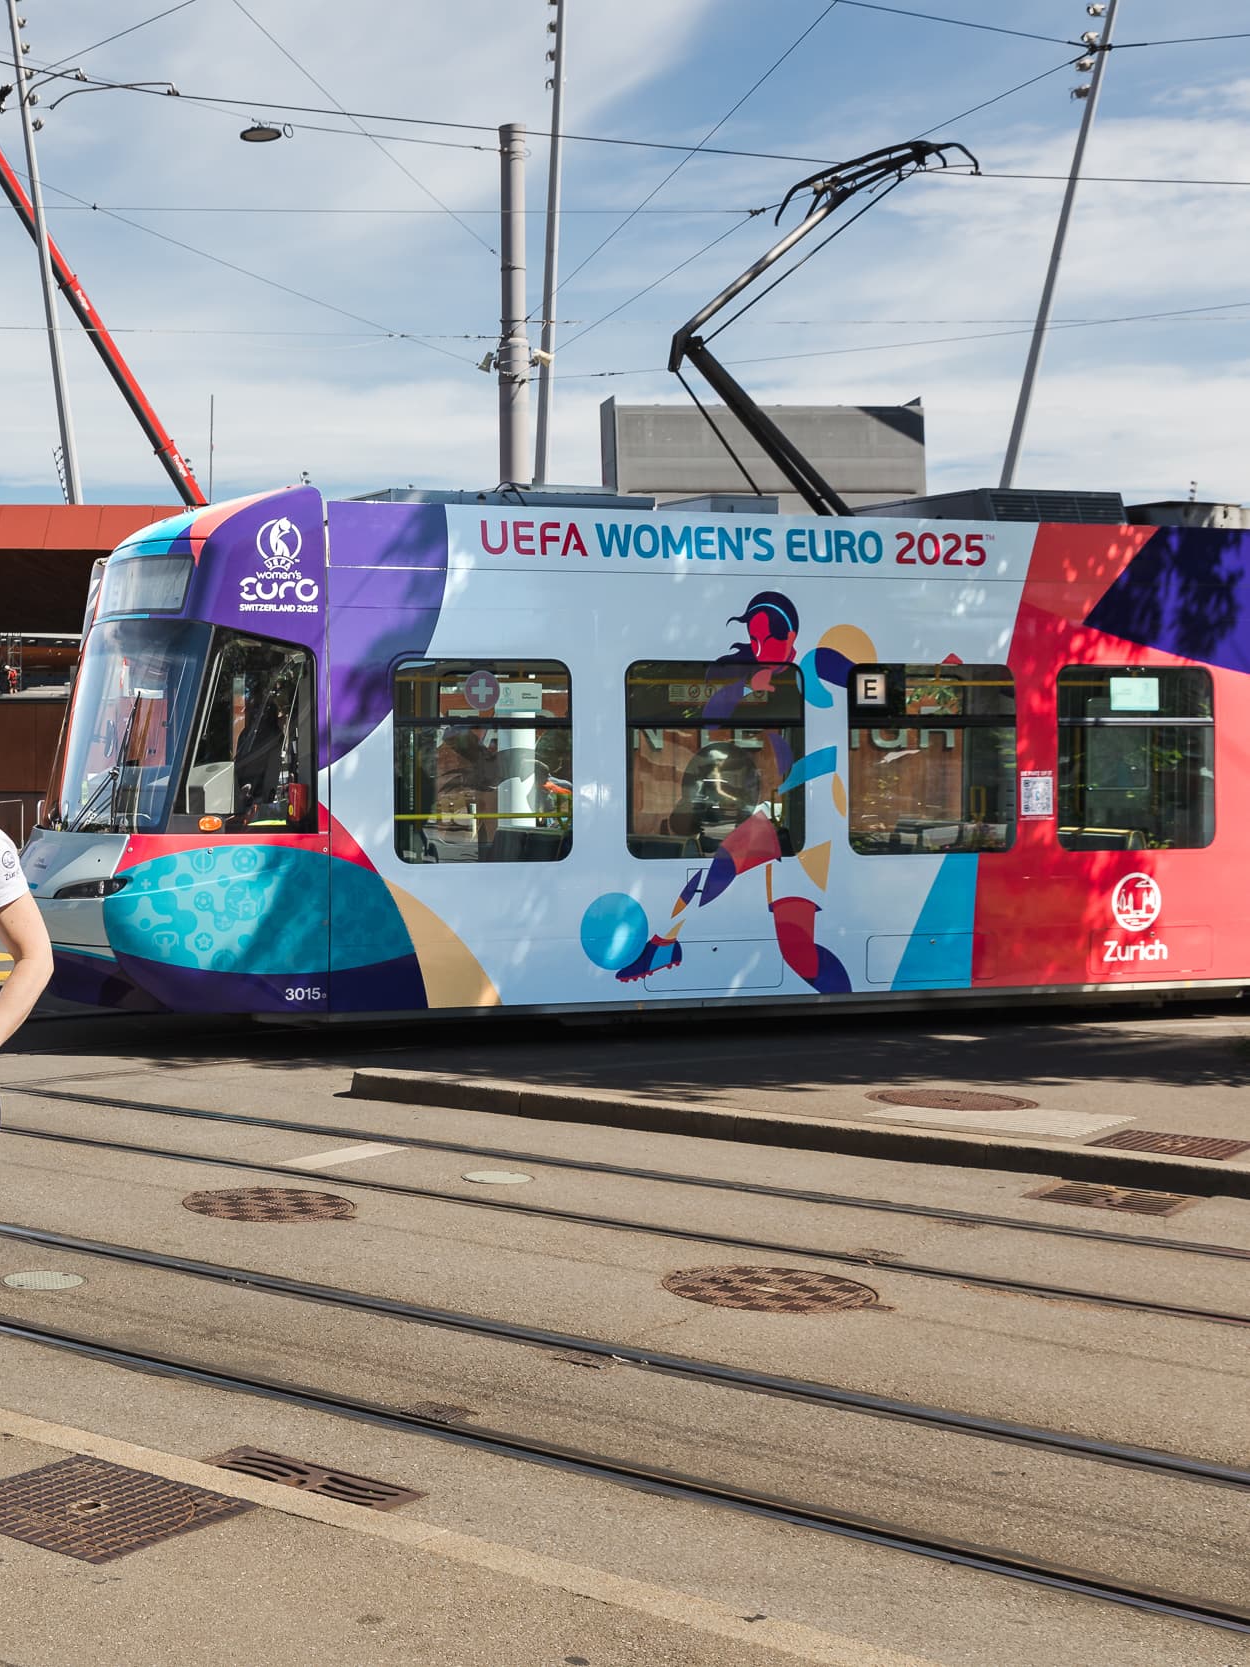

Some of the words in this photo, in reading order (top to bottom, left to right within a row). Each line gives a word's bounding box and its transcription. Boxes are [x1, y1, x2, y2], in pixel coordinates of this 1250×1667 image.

[480, 520, 589, 557] UEFA
[595, 523, 775, 561] WOMEN'S
[786, 528, 883, 564] EURO
[264, 558, 293, 571] UEFA
[256, 570, 302, 580] women's
[239, 603, 296, 613] SWITZERLAND
[296, 604, 319, 613] 2025
[864, 679, 878, 699] E
[1103, 939, 1168, 962] Zurich
[285, 987, 321, 1001] 3015
